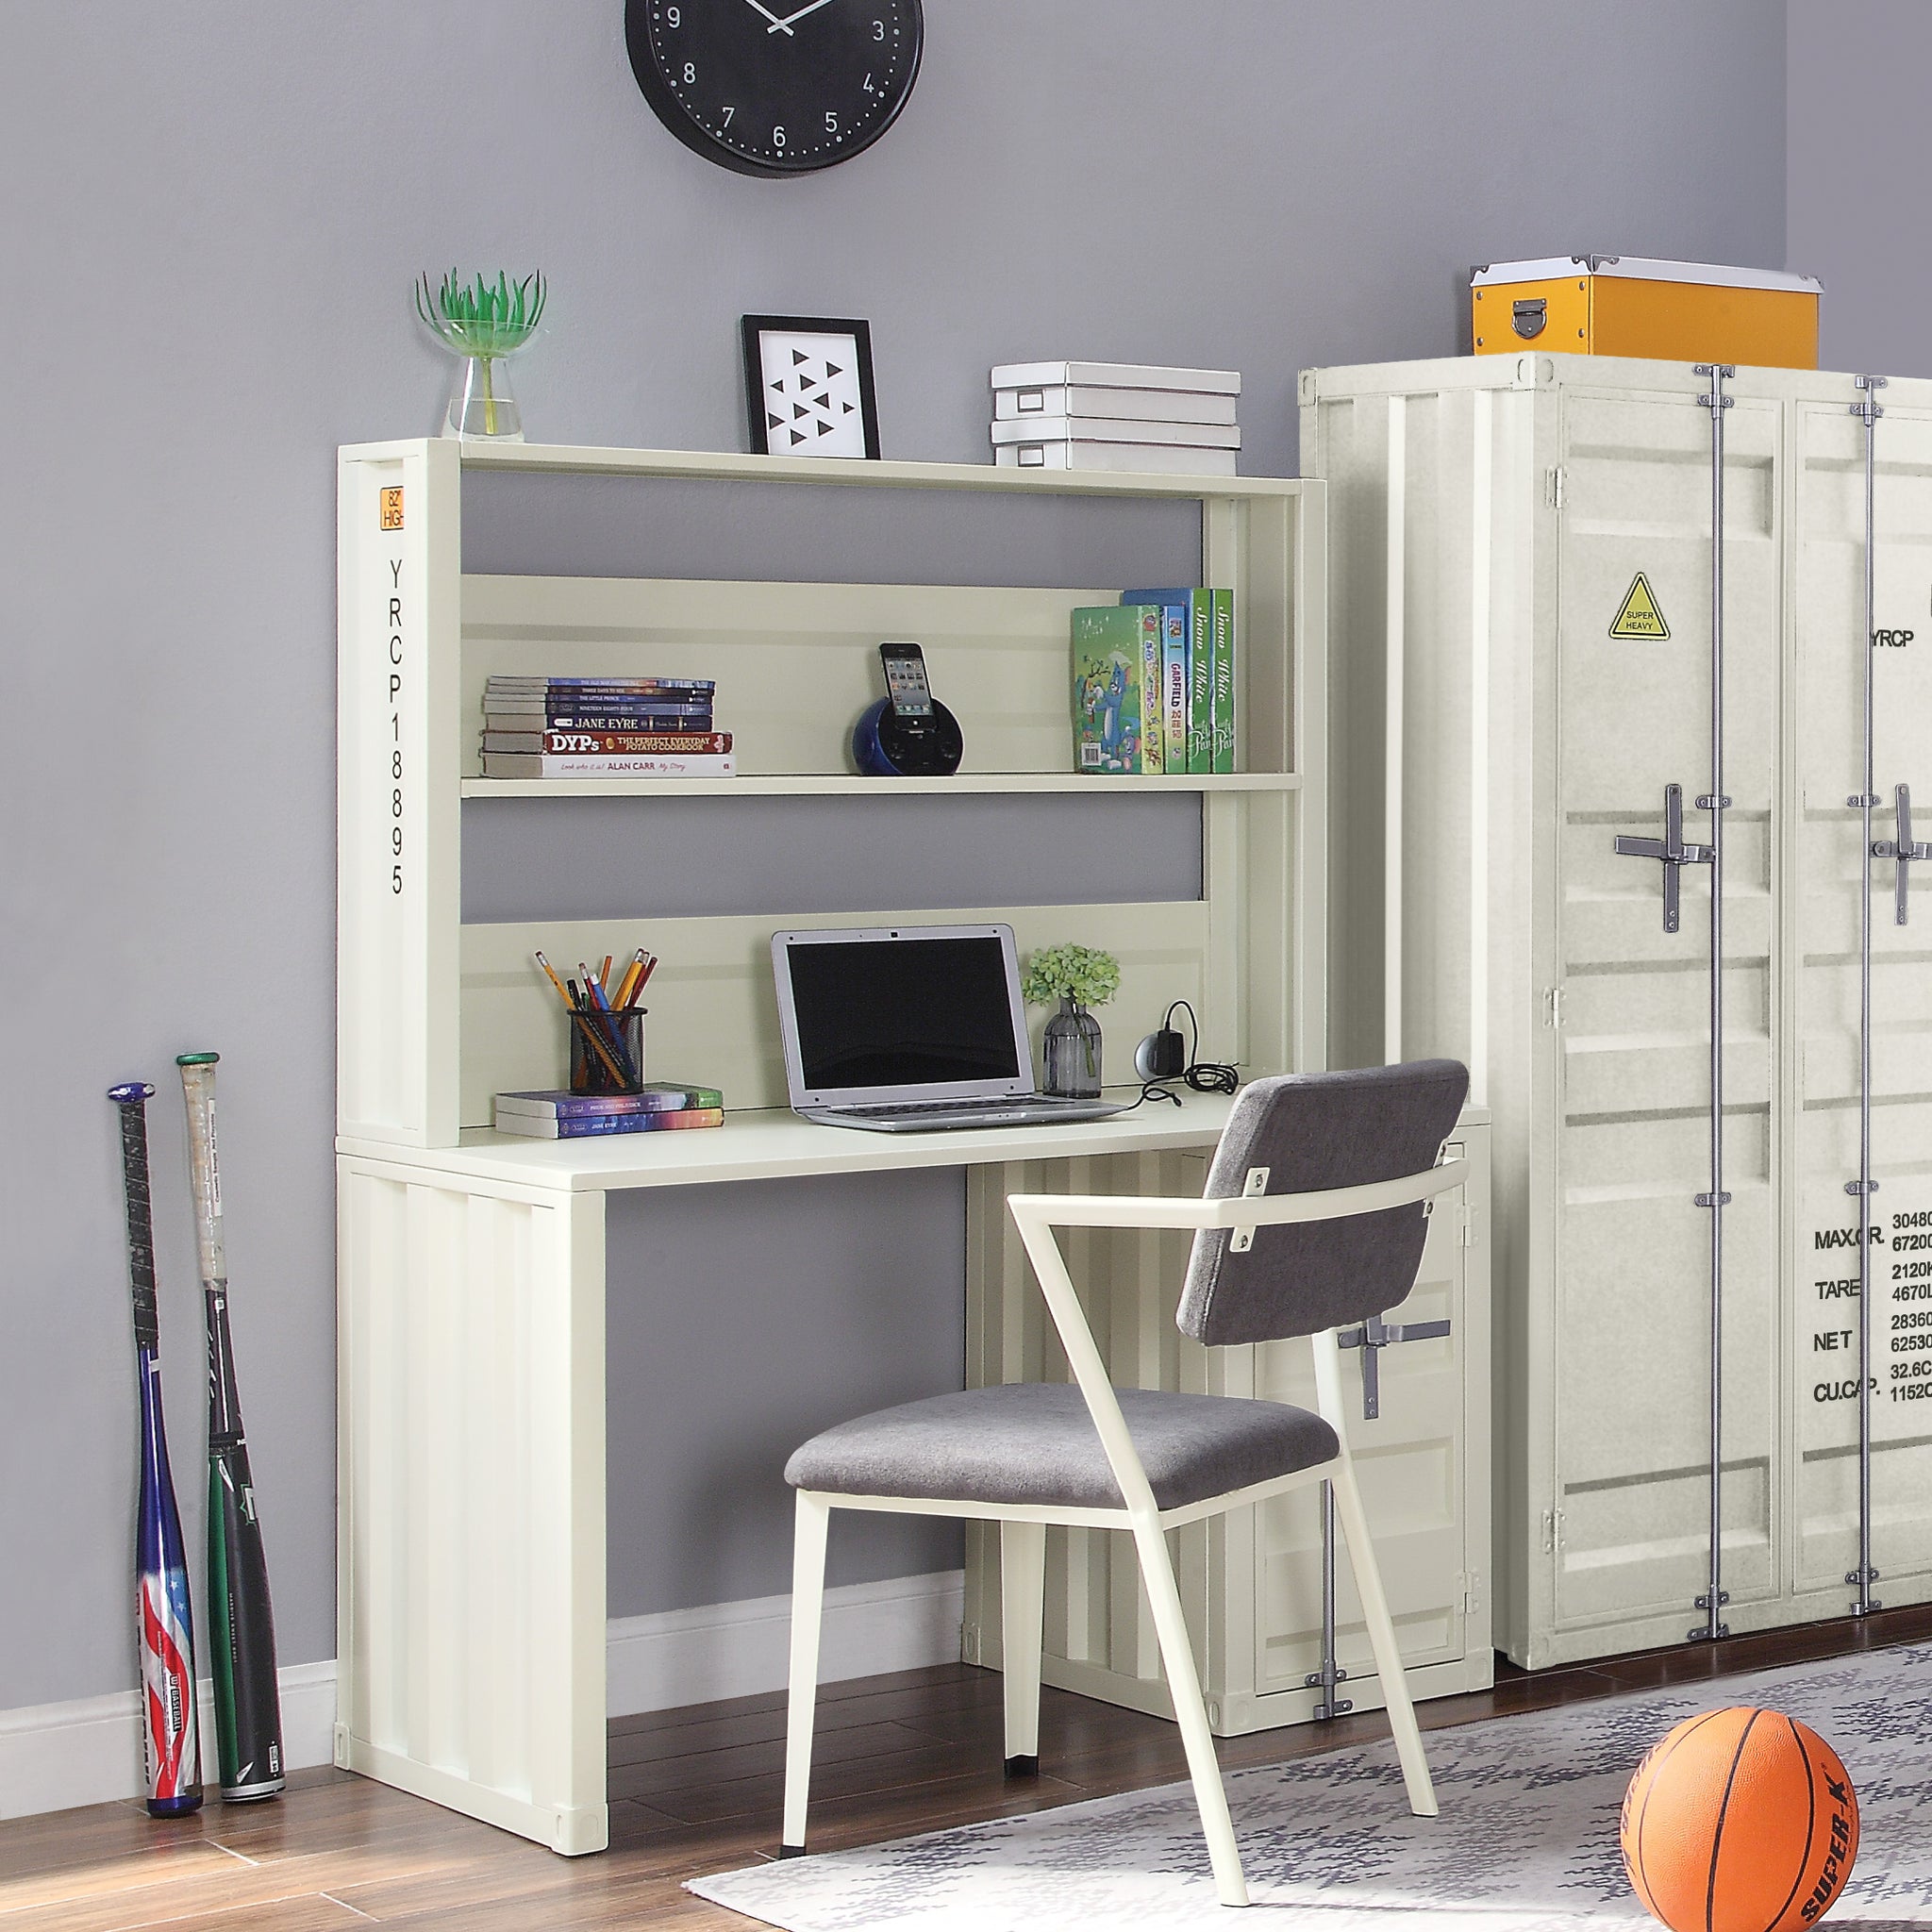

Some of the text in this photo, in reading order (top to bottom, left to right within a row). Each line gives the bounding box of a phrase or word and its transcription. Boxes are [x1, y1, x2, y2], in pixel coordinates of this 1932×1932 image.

[667, 7, 680, 28] 9
[873, 21, 885, 41] 3
[683, 62, 695, 84] 8
[862, 73, 874, 93] 4
[722, 107, 735, 128] 7
[824, 111, 837, 132] 5
[773, 125, 786, 147] 6
[1626, 610, 1654, 620] SUPER
[1625, 622, 1654, 630] HEAVY
[1196, 607, 1208, 704] Snow White
[1218, 606, 1229, 702] Snow White
[1171, 662, 1181, 708] GARFIELD
[575, 718, 606, 728] JANE
[608, 717, 638, 729] EYRE
[671, 737, 710, 745] EVERYDAY
[608, 762, 631, 771] ALAN
[633, 762, 655, 771] CARR
[1814, 1278, 1861, 1300] TARE
[1813, 1311, 1932, 1352] NET 28360
[1890, 1334, 1932, 1353] 62530
[1890, 1360, 1932, 1379] 32.6C
[172, 1690, 181, 1730] BASEBALL
